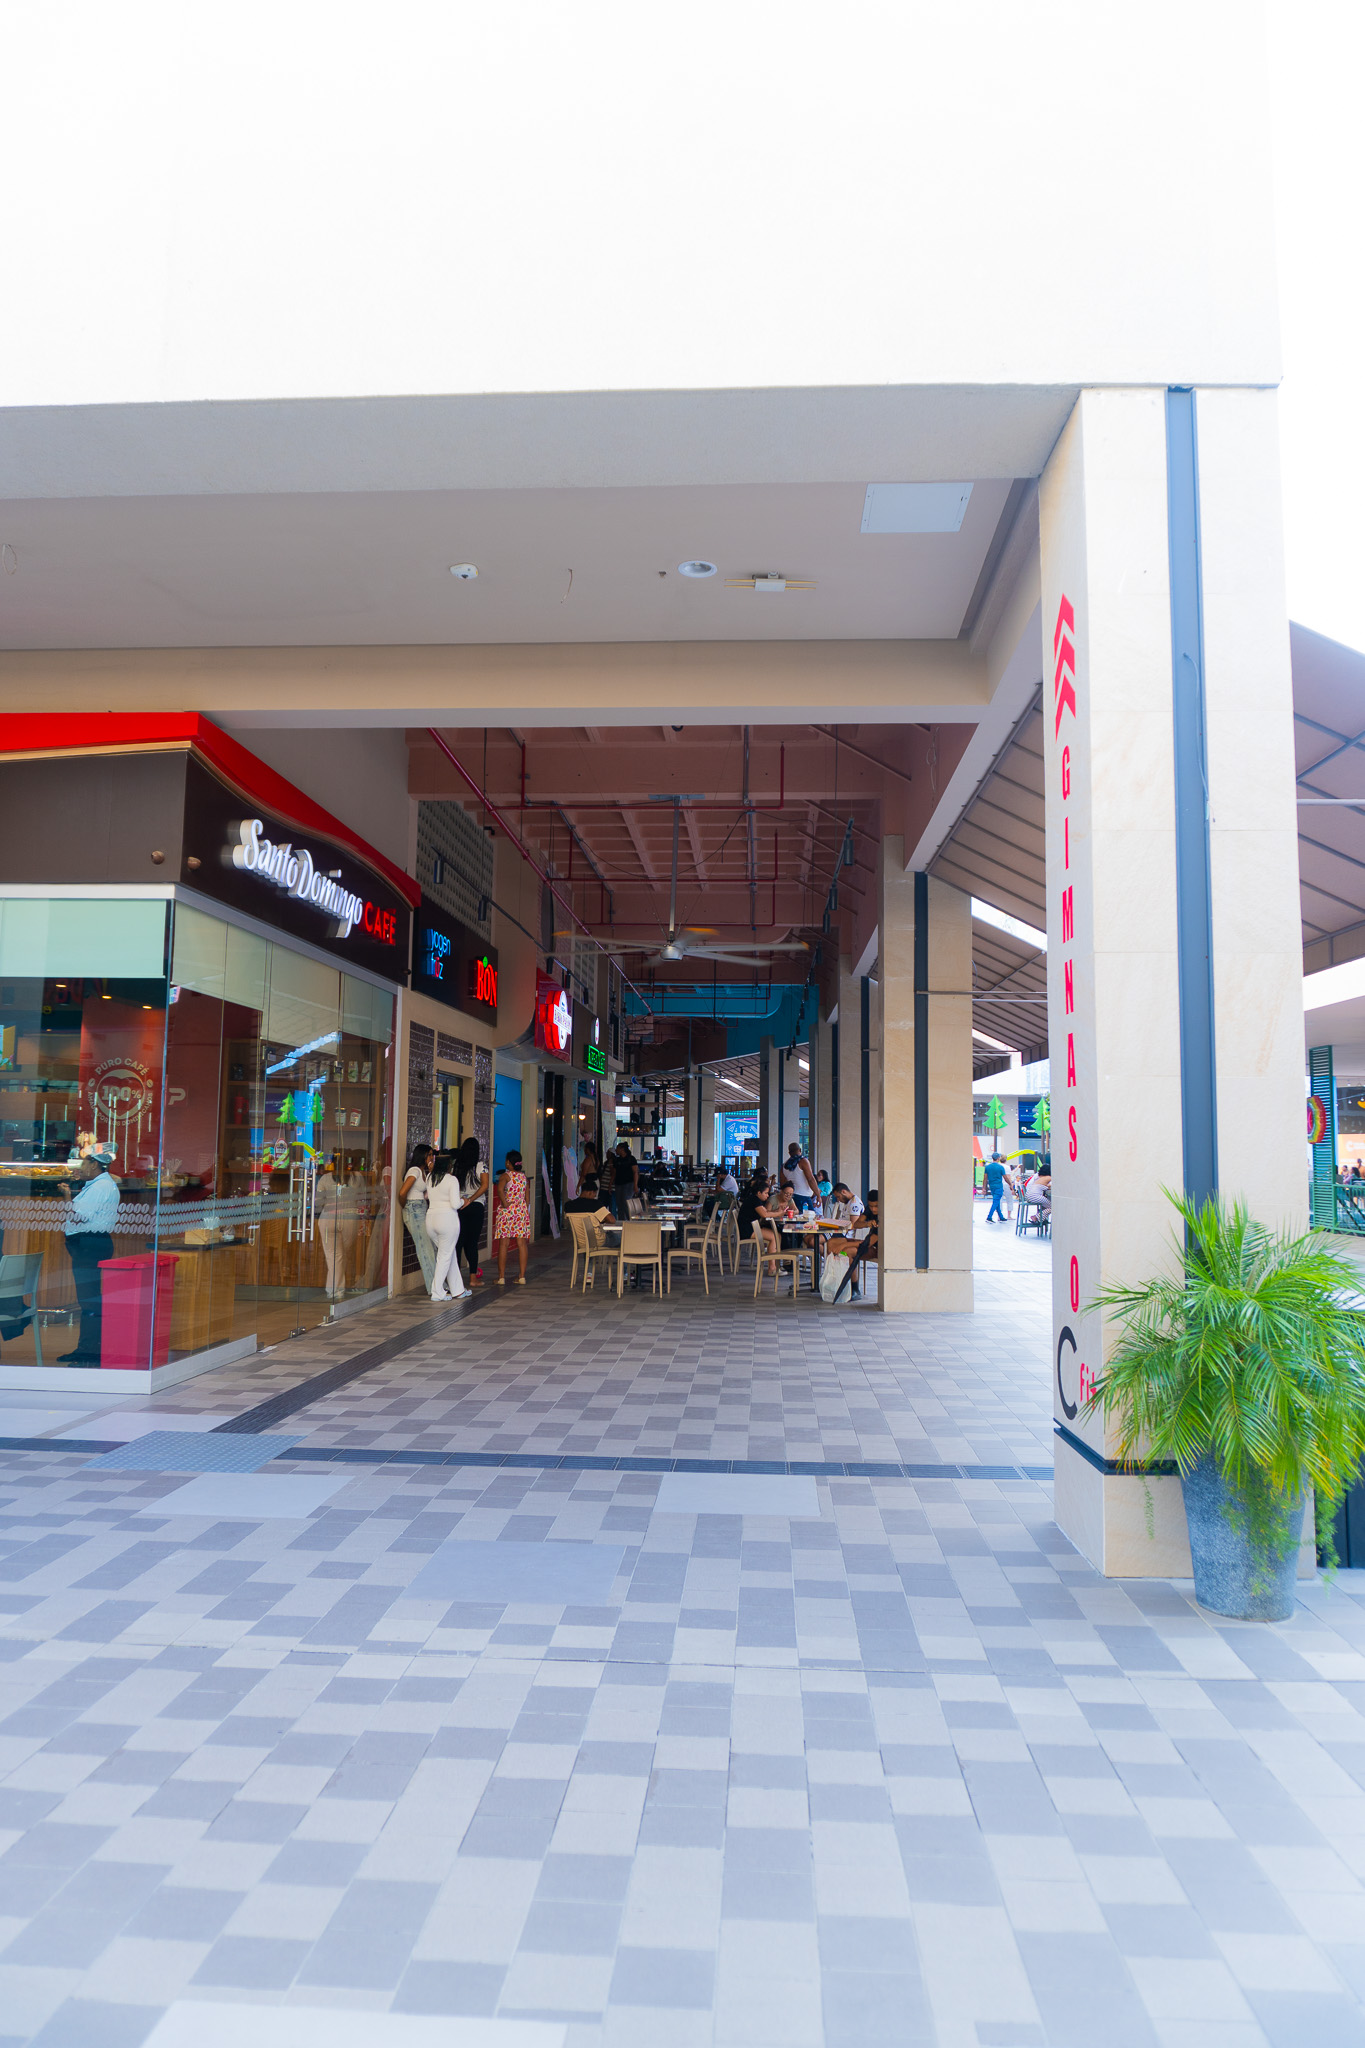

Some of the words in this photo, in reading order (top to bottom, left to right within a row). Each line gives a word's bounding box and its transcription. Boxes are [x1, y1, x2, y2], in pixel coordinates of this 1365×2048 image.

[233, 819, 298, 887] Santo
[288, 849, 363, 938] Domingo
[430, 928, 451, 957] yogen
[477, 959, 498, 1007] BON
[94, 1057, 122, 1075] PURO
[124, 1058, 150, 1076] CAFÉ
[101, 1086, 141, 1101] 100%
